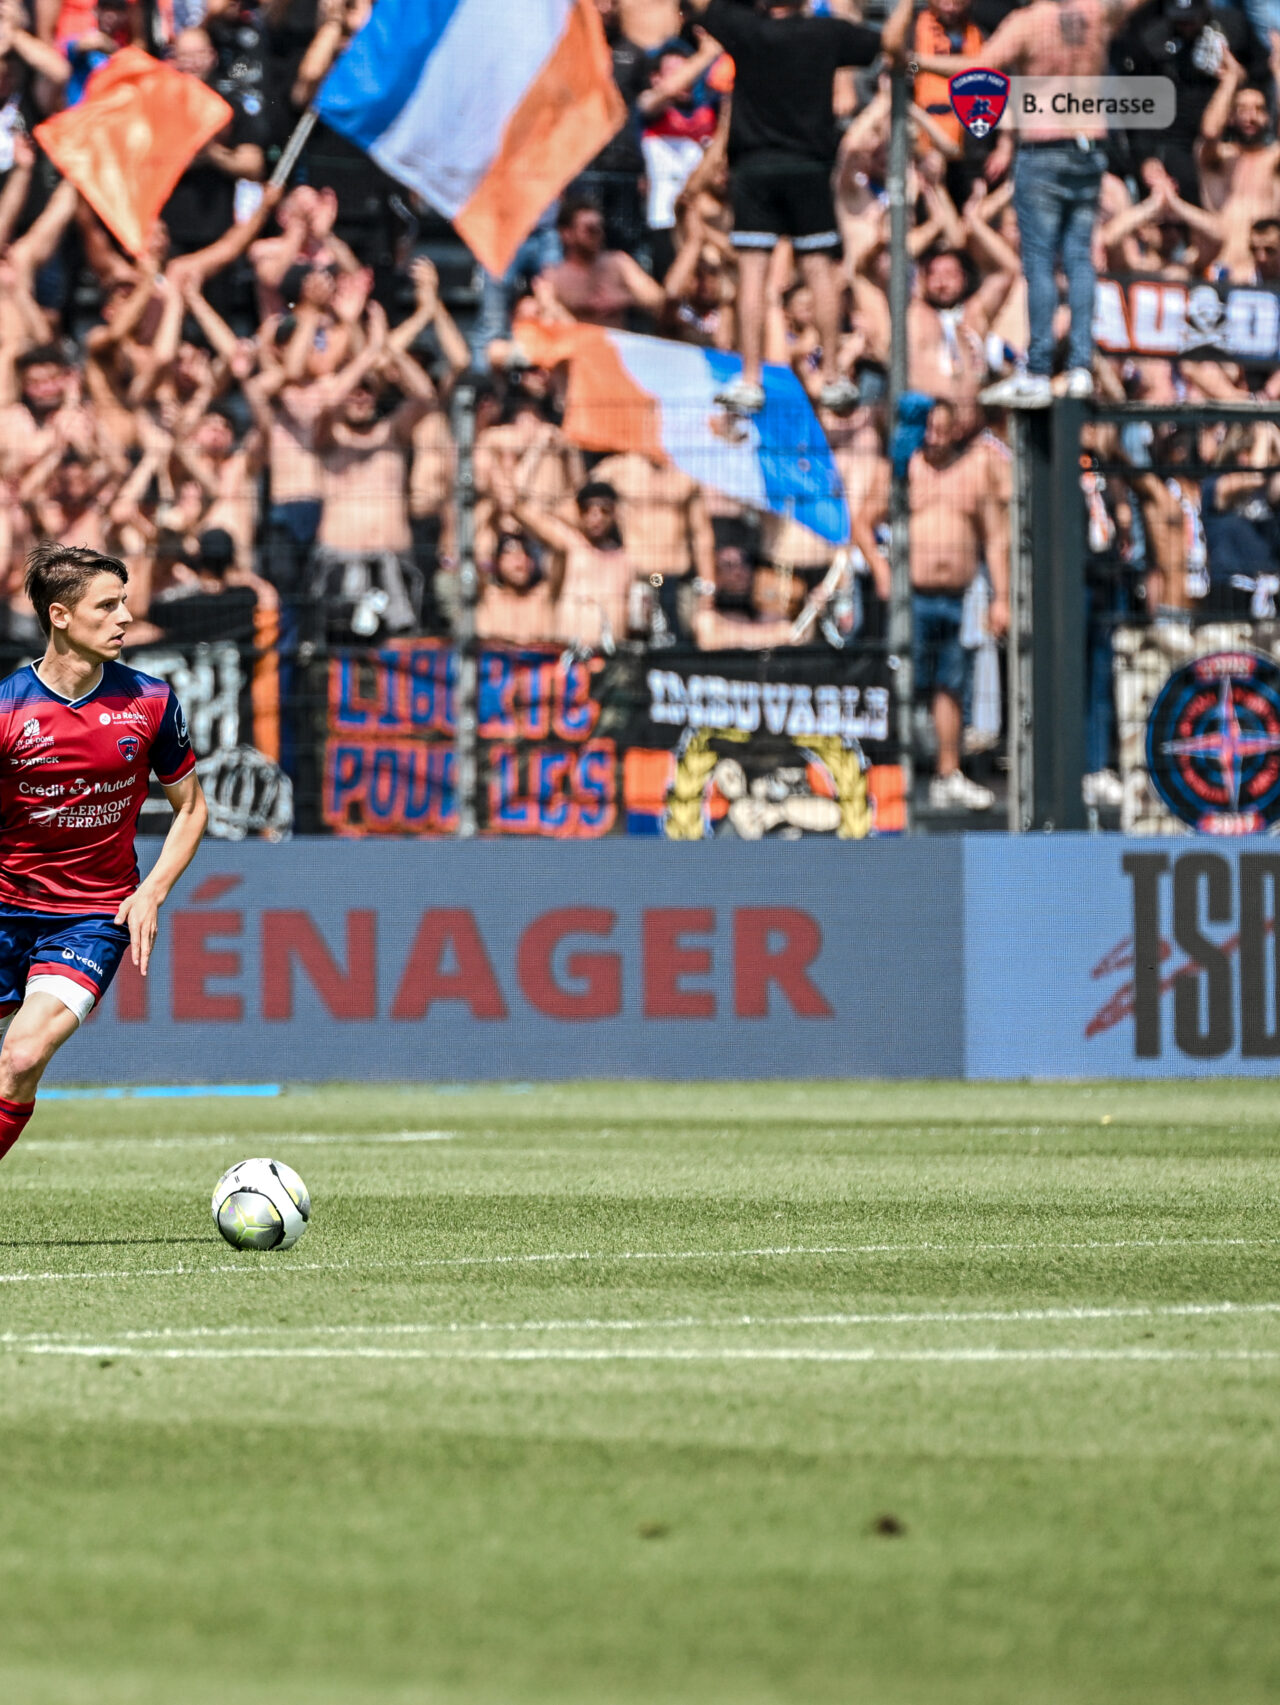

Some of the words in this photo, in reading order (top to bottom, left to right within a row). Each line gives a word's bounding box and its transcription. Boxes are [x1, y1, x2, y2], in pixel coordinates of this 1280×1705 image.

[20, 756, 60, 766] PATRICK
[19, 781, 66, 797] Crédit
[59, 795, 133, 816] CLERMONT
[58, 811, 122, 828] FERRAND
[76, 955, 104, 977] VEOLIA
